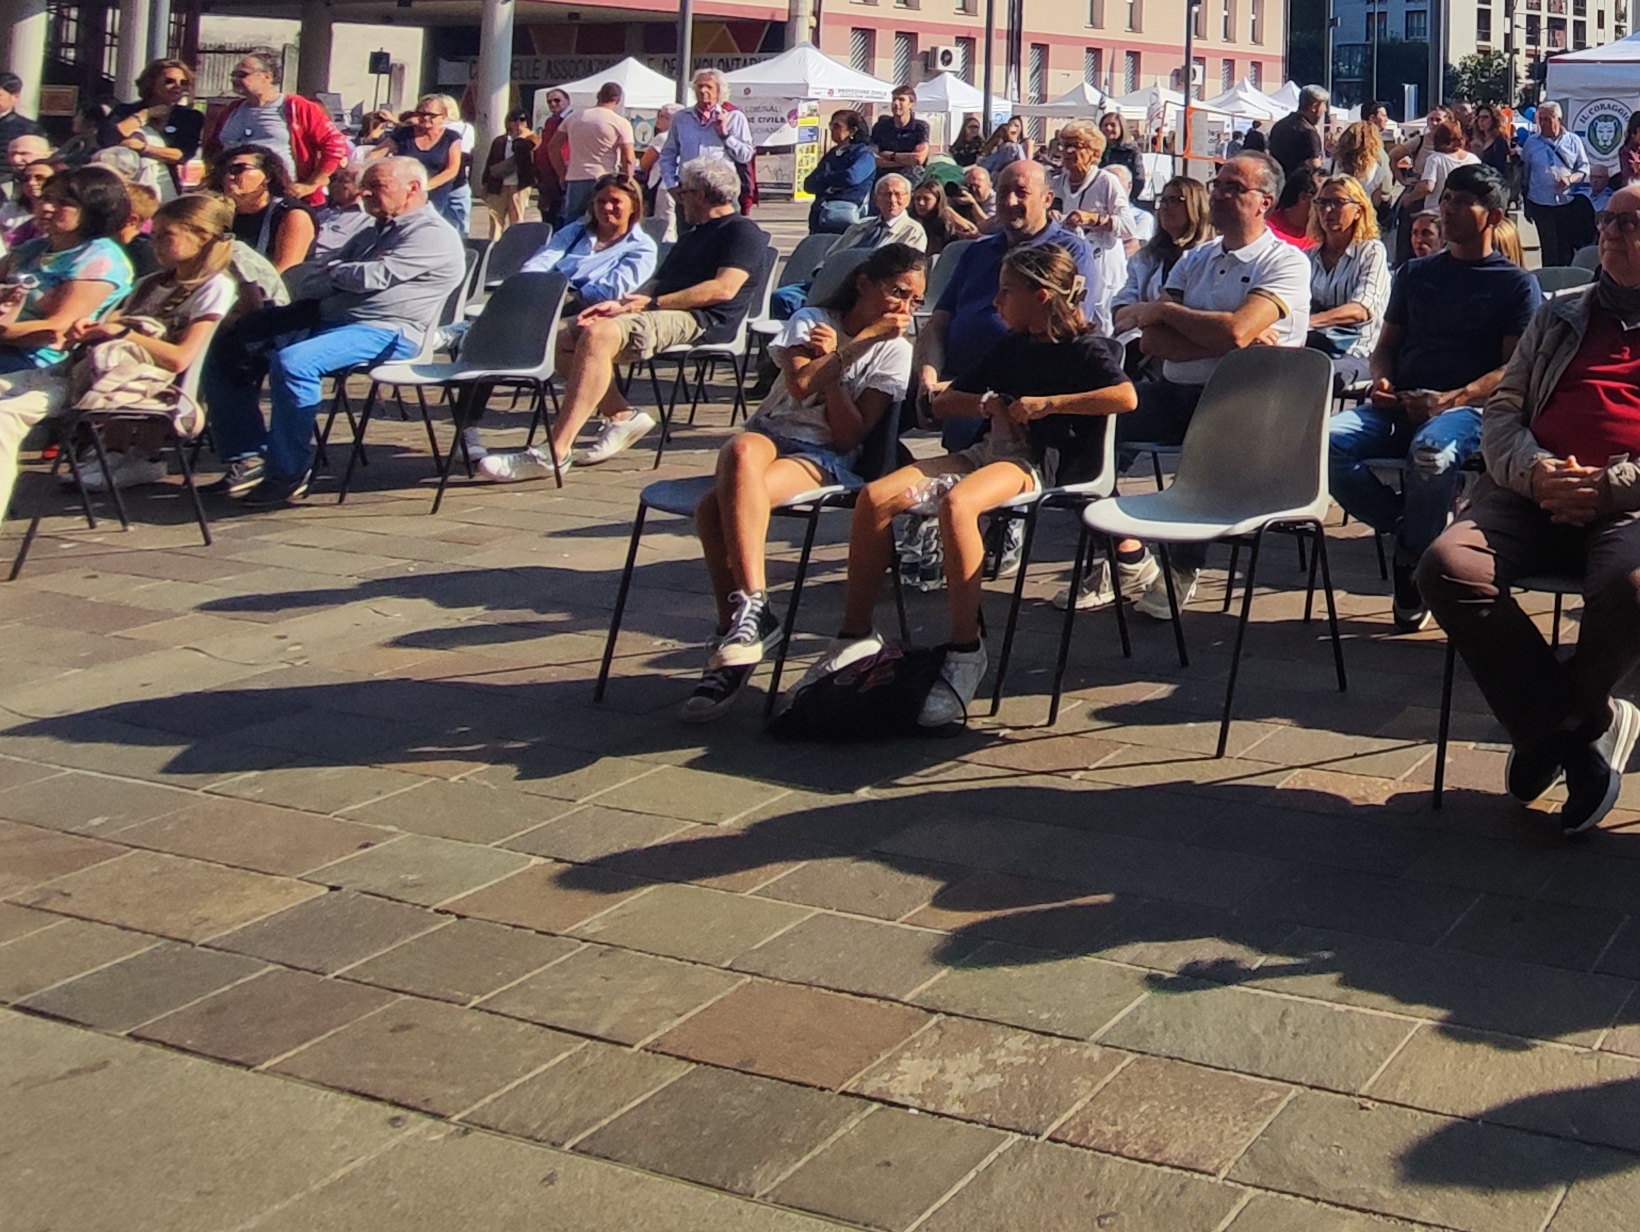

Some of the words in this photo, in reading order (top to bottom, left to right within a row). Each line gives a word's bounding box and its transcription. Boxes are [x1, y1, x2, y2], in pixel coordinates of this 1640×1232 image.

[511, 59, 541, 80] ELLE
[1579, 114, 1590, 124] IL
[1588, 103, 1630, 122] CORAGGIO
